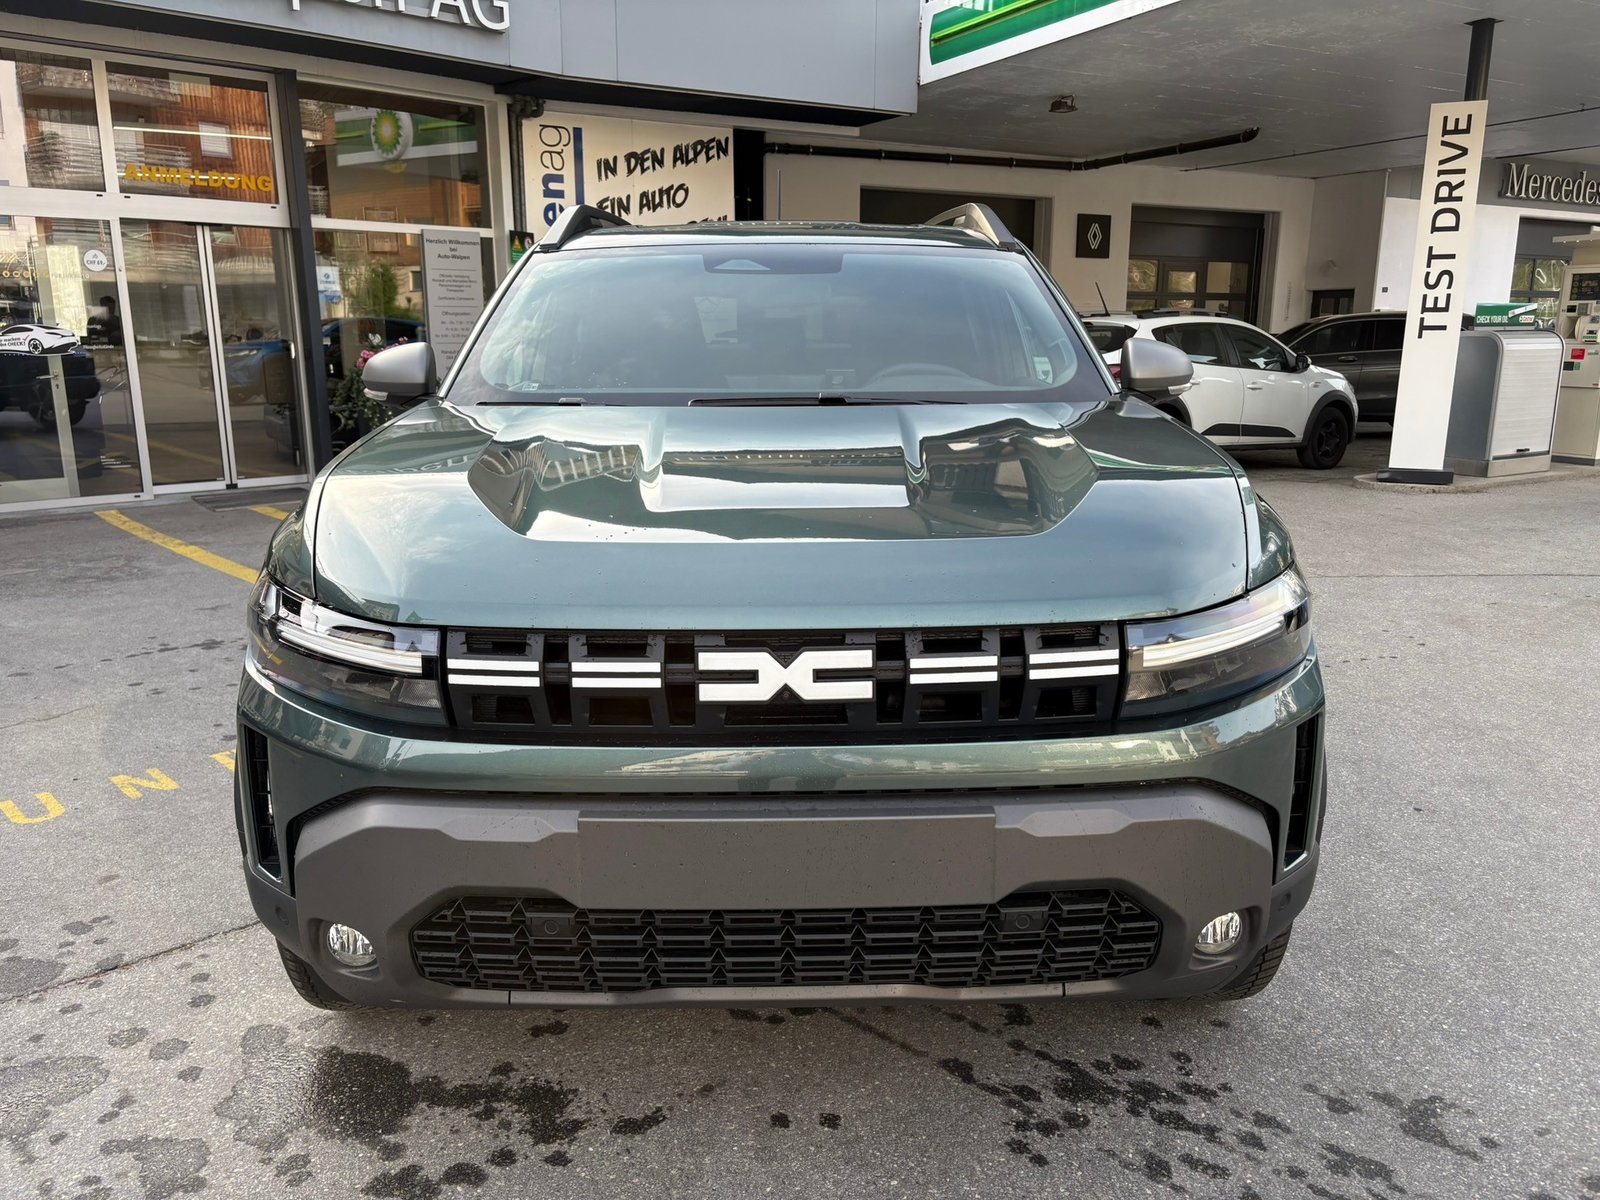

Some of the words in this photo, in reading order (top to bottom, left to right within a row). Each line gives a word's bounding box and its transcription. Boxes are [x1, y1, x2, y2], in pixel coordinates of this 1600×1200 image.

[124, 163, 273, 192] ANMELDUNG
[596, 155, 618, 183] IN
[624, 147, 665, 178] DEN
[672, 136, 730, 169] ALPEN
[1430, 113, 1473, 234] DRIVE
[596, 194, 631, 218] EIN
[639, 183, 690, 216] AUTO
[1417, 246, 1457, 339] TEST
[1476, 315, 1490, 323] CHECK
[1491, 315, 1502, 323] YOUR
